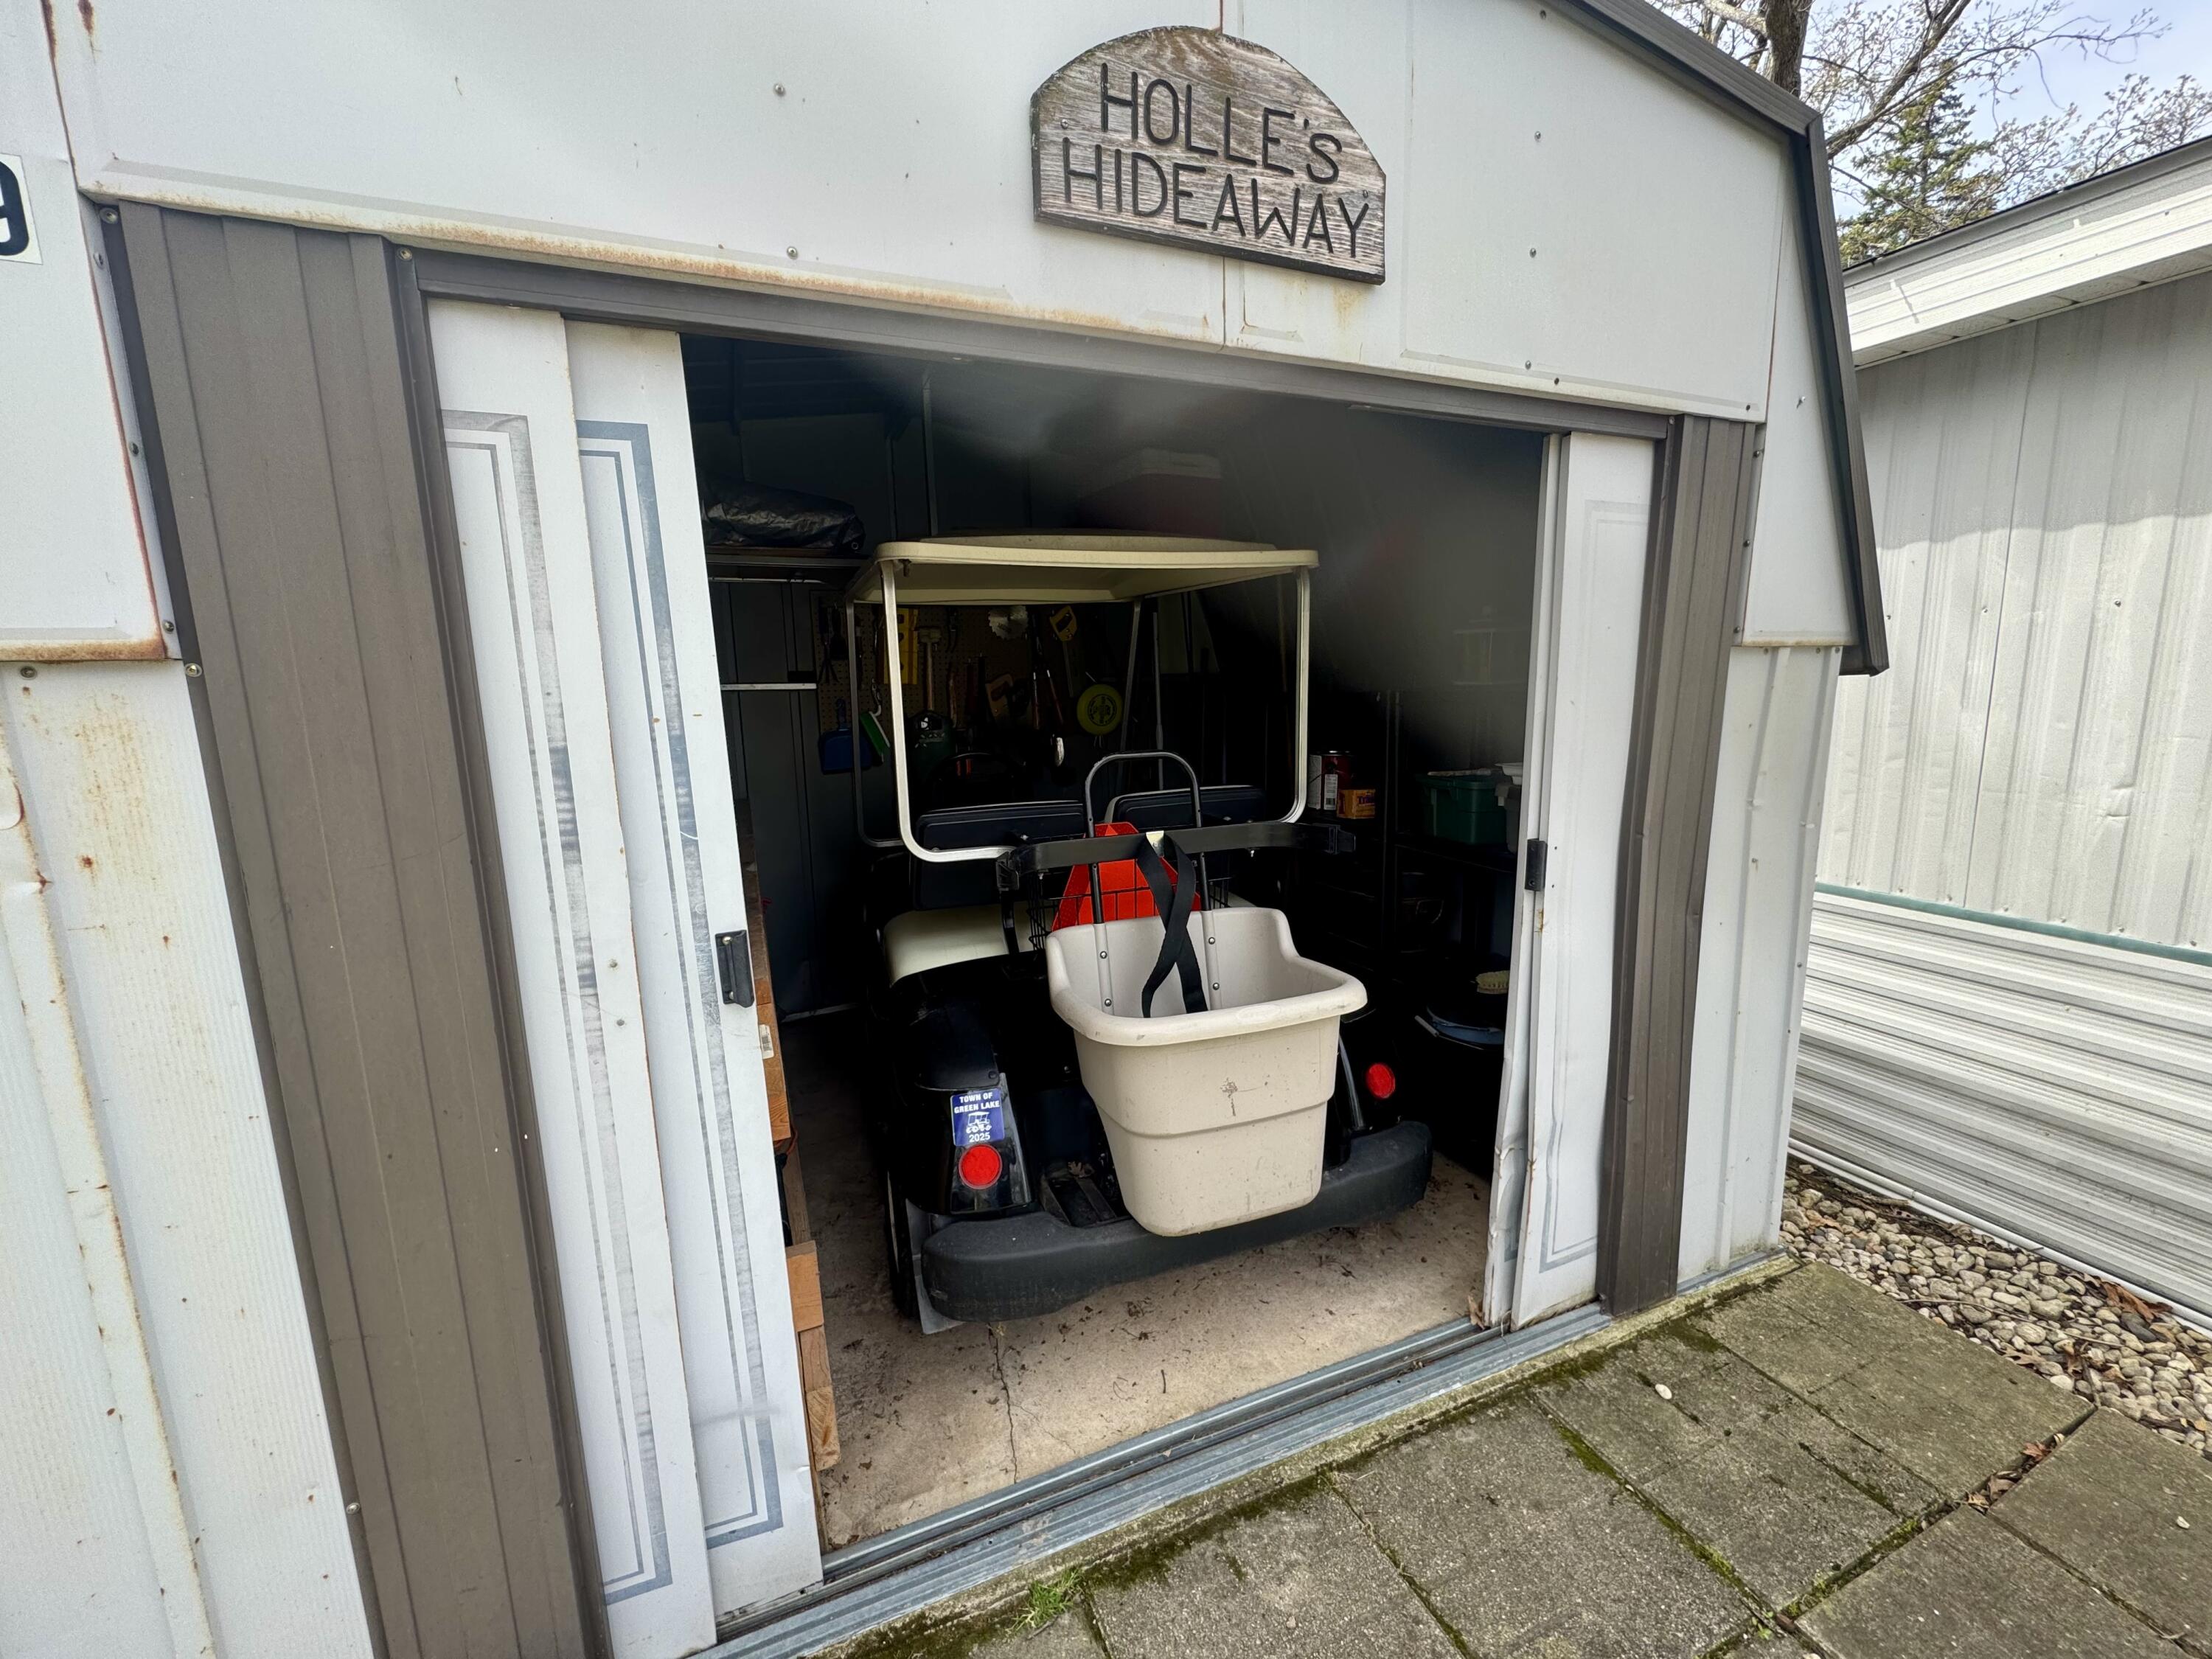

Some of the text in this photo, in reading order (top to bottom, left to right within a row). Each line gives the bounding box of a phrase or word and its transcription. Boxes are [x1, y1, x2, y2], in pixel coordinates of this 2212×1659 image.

[1100, 62, 1343, 185] HOLLE'S
[1062, 136, 1370, 259] HIDEAWAY
[959, 1092, 993, 1103] TOWN OF
[954, 1100, 1000, 1113] GREEN LAKE
[969, 1132, 991, 1142] 2025
